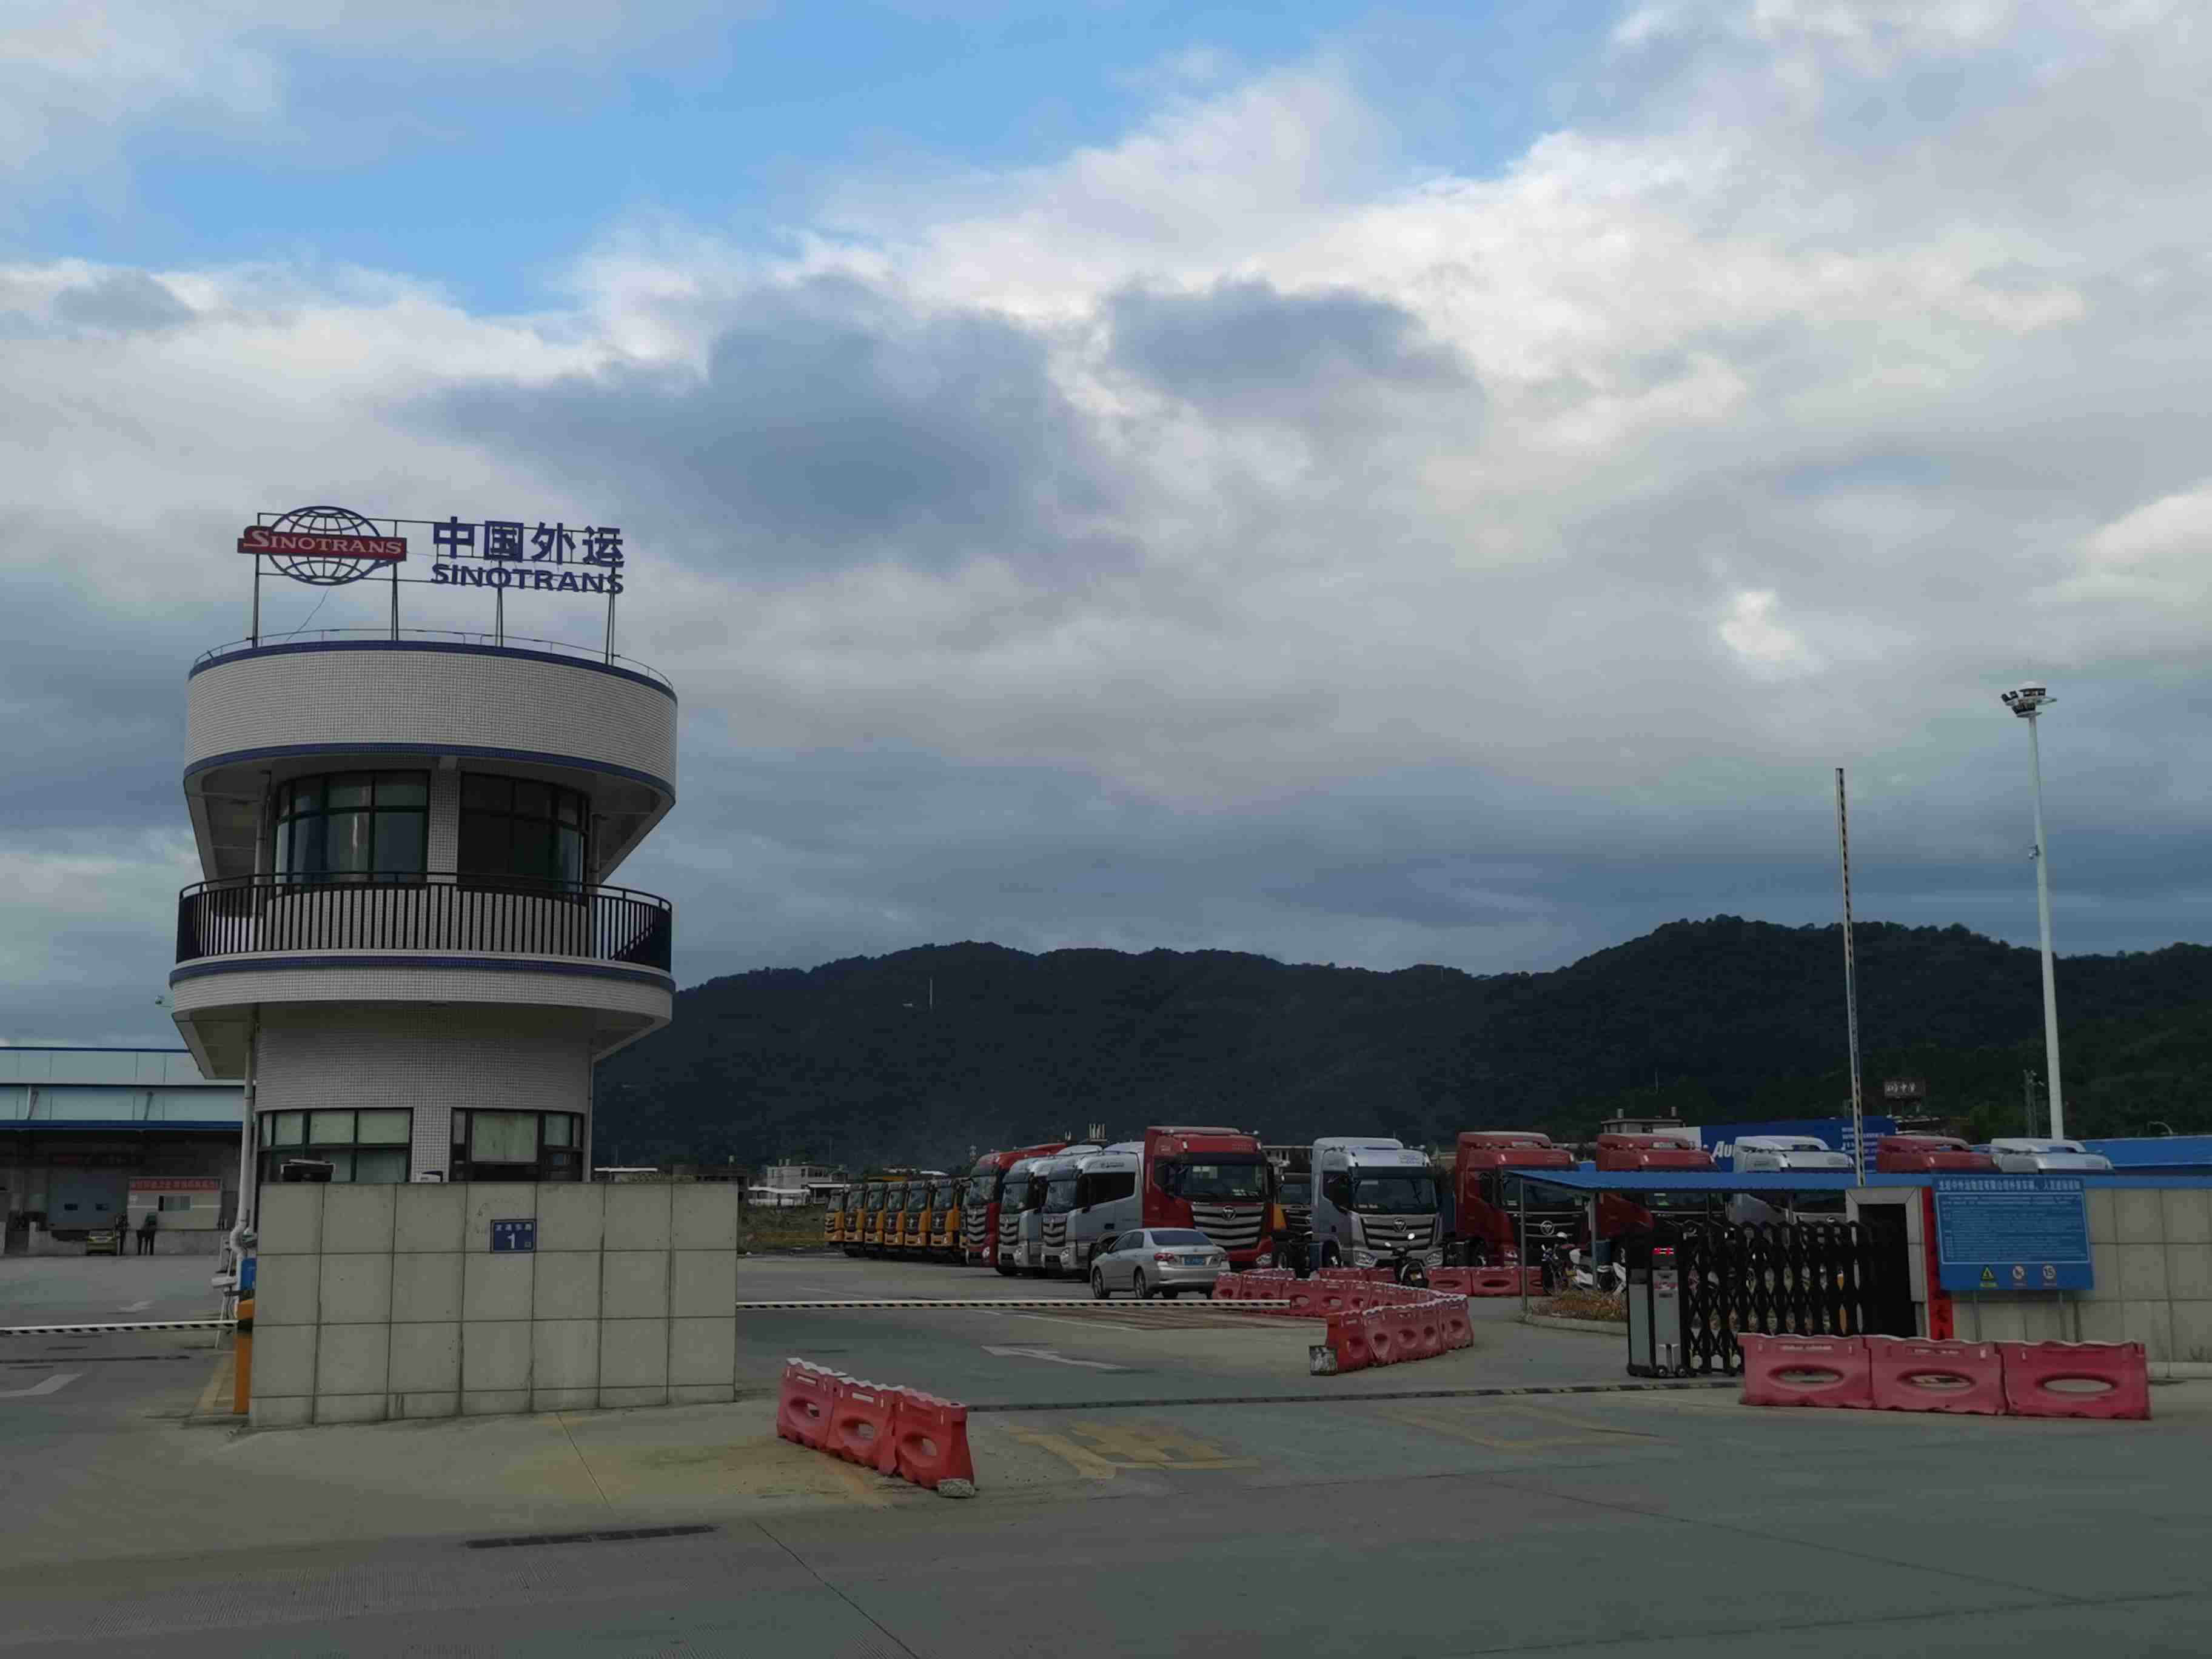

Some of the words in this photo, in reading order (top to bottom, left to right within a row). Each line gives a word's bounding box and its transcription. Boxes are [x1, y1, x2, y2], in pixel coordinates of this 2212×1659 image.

[244, 530, 402, 554] SINOTRANS
[433, 516, 625, 568] 中国外运
[431, 563, 623, 594] SINOTRANS
